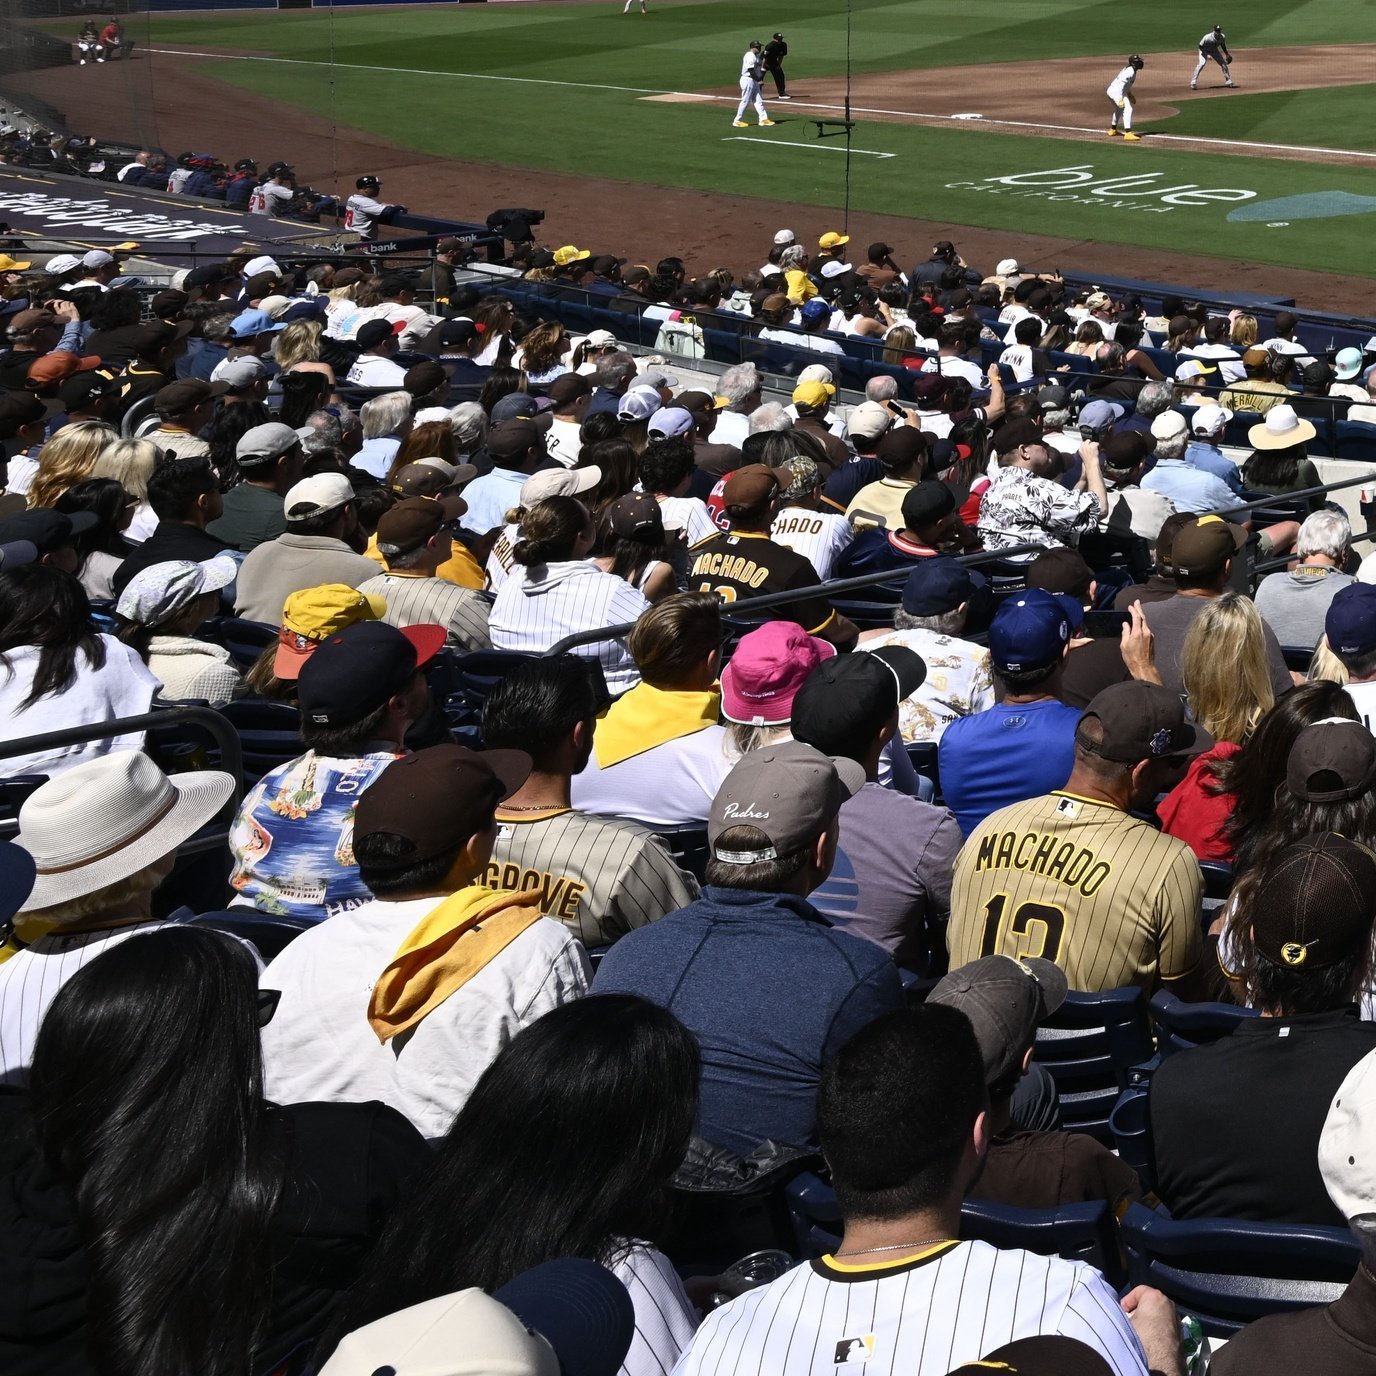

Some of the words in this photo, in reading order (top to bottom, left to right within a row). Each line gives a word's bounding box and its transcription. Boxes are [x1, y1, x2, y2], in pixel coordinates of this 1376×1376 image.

[945, 181, 1175, 213] CALIFORNIA
[984, 165, 1257, 205] blue
[723, 801, 770, 821] Padres
[974, 830, 1113, 899] MACHADO
[980, 892, 1069, 965] 13
